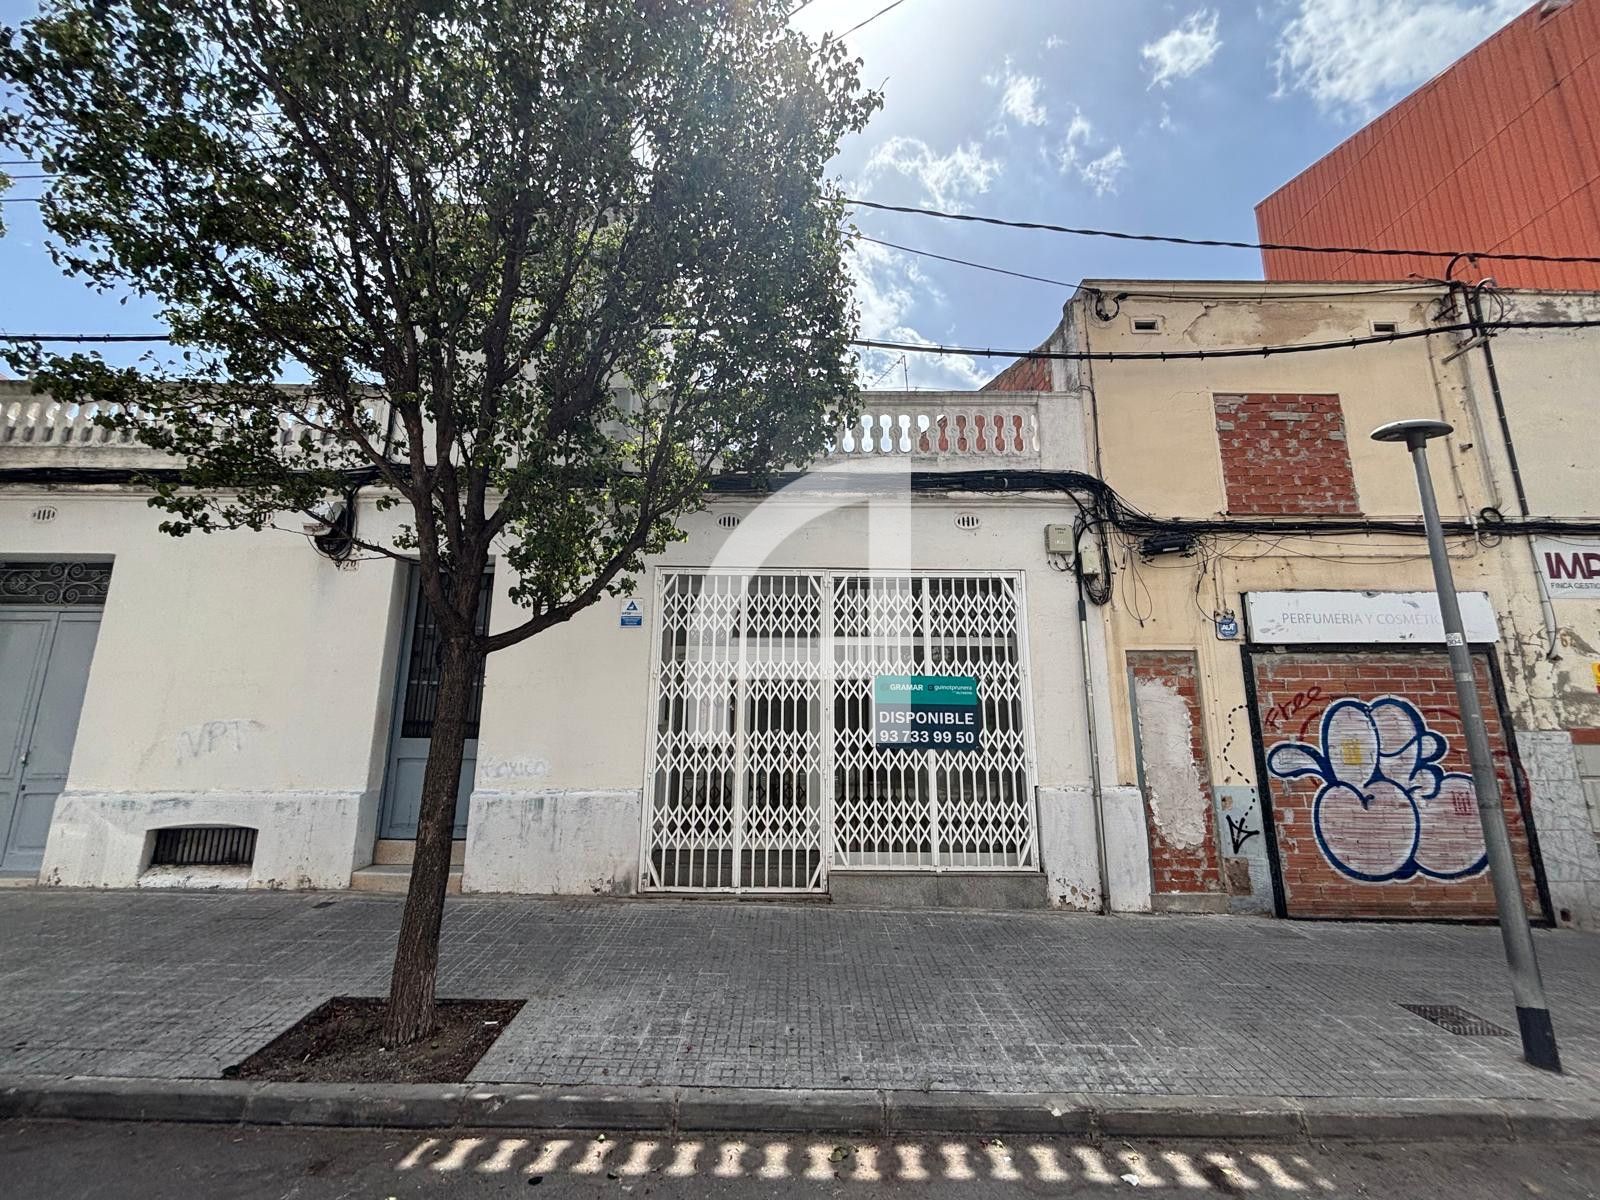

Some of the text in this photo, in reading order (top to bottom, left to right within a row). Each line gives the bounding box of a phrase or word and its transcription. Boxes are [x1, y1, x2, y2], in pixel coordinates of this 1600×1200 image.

[1282, 612, 1363, 624] PERFUMERIA
[1364, 613, 1373, 624] Y
[889, 683, 924, 691] GRAMAR
[879, 711, 975, 725] DISPONIBLE
[880, 730, 975, 744] 93 733 99 50
